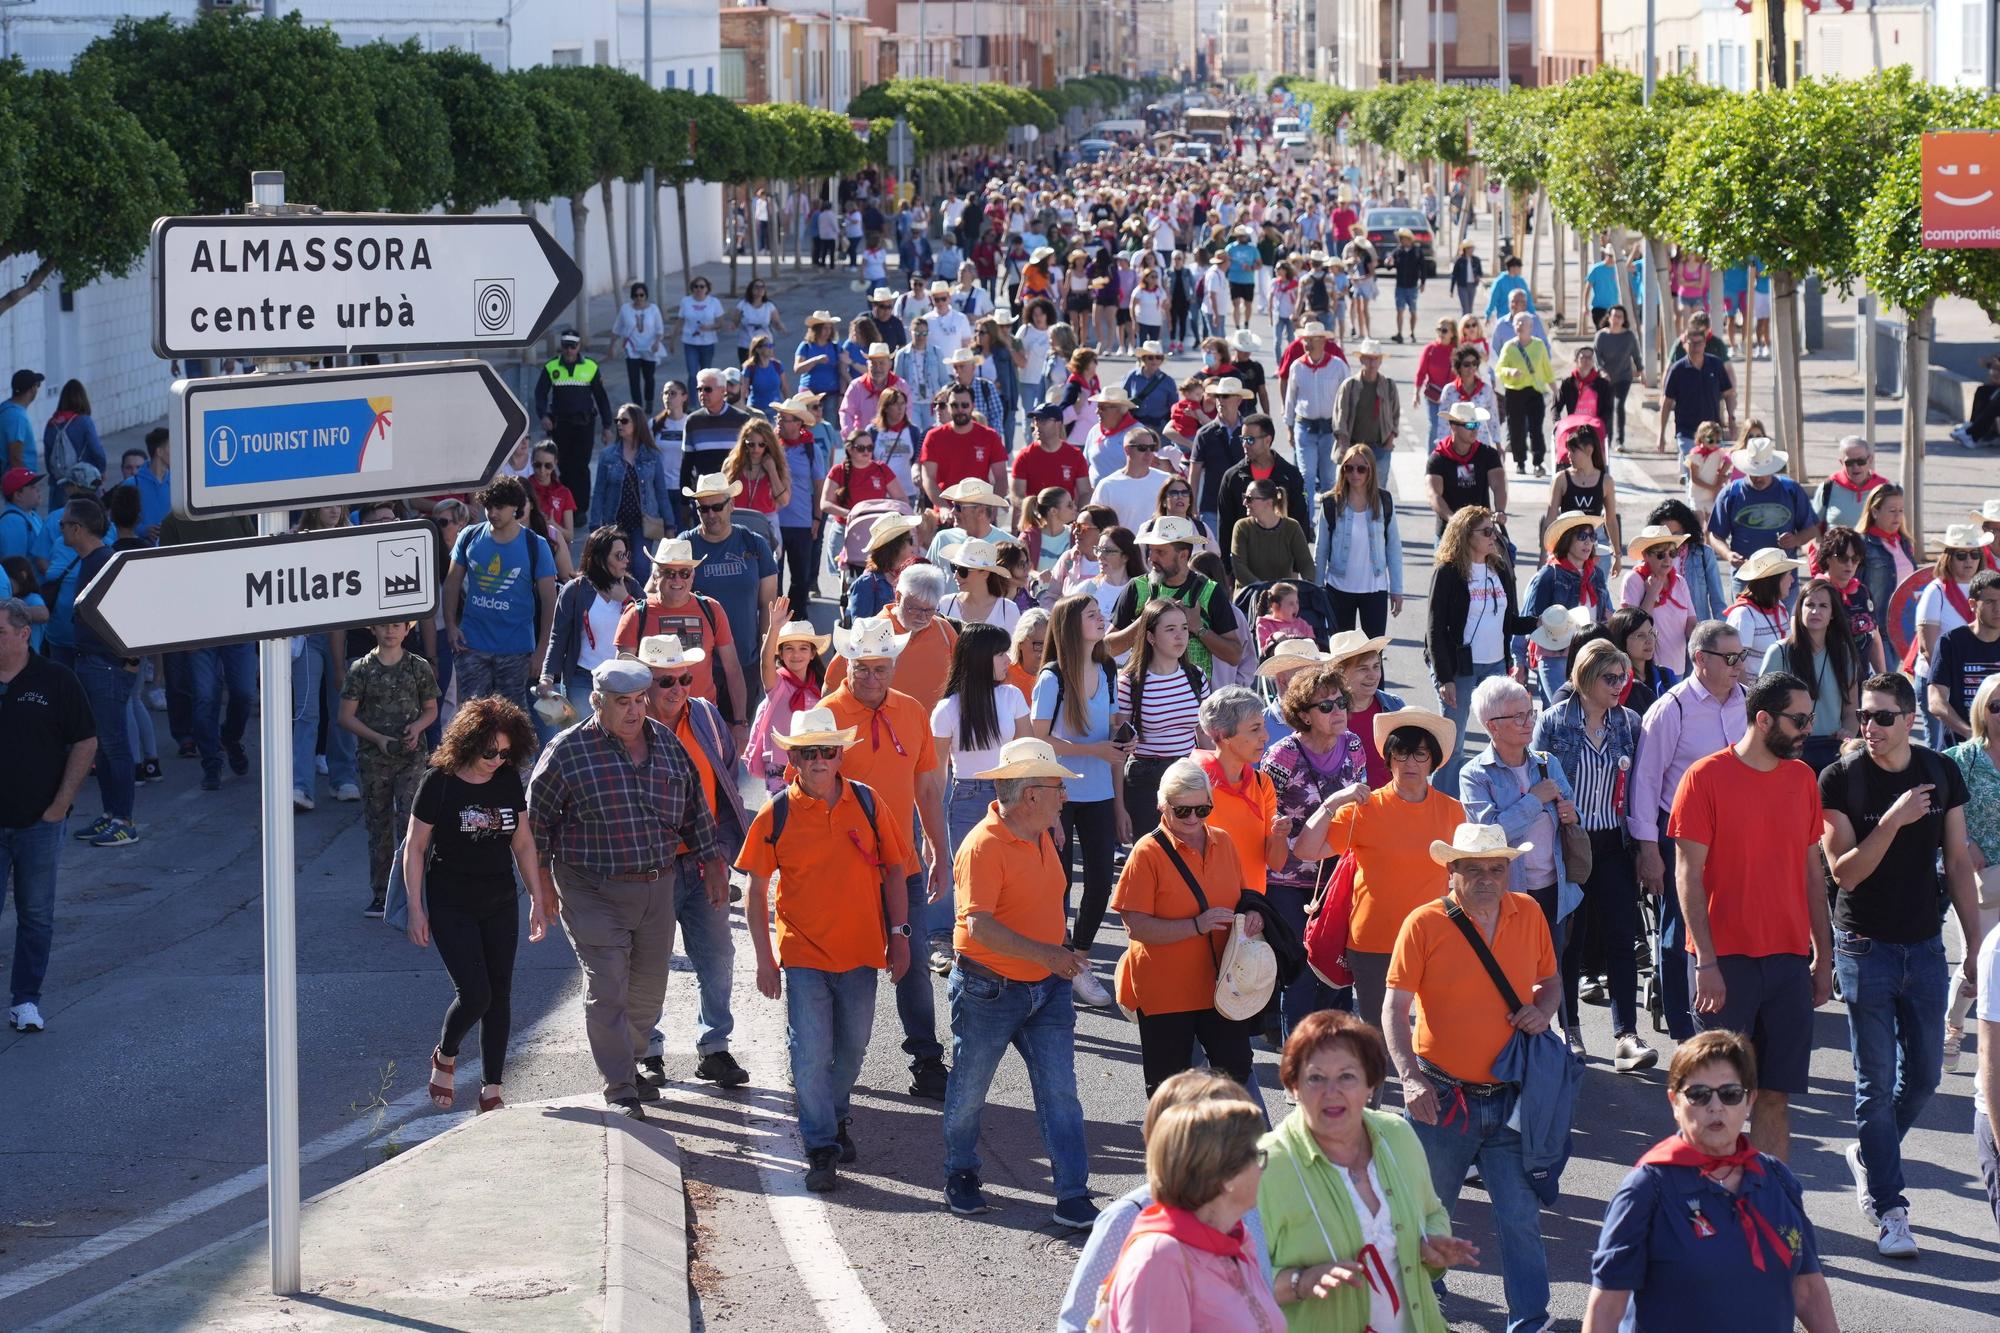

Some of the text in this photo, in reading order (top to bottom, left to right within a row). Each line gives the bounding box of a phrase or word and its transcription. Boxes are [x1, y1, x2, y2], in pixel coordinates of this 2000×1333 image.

[190, 237, 432, 273] ALMASSORA
[190, 293, 415, 332] centre urbà
[241, 430, 309, 454] TOURIST
[313, 425, 350, 448] INFO
[1574, 495, 1594, 508] W
[246, 566, 362, 608] Millars
[471, 595, 510, 611] adidas
